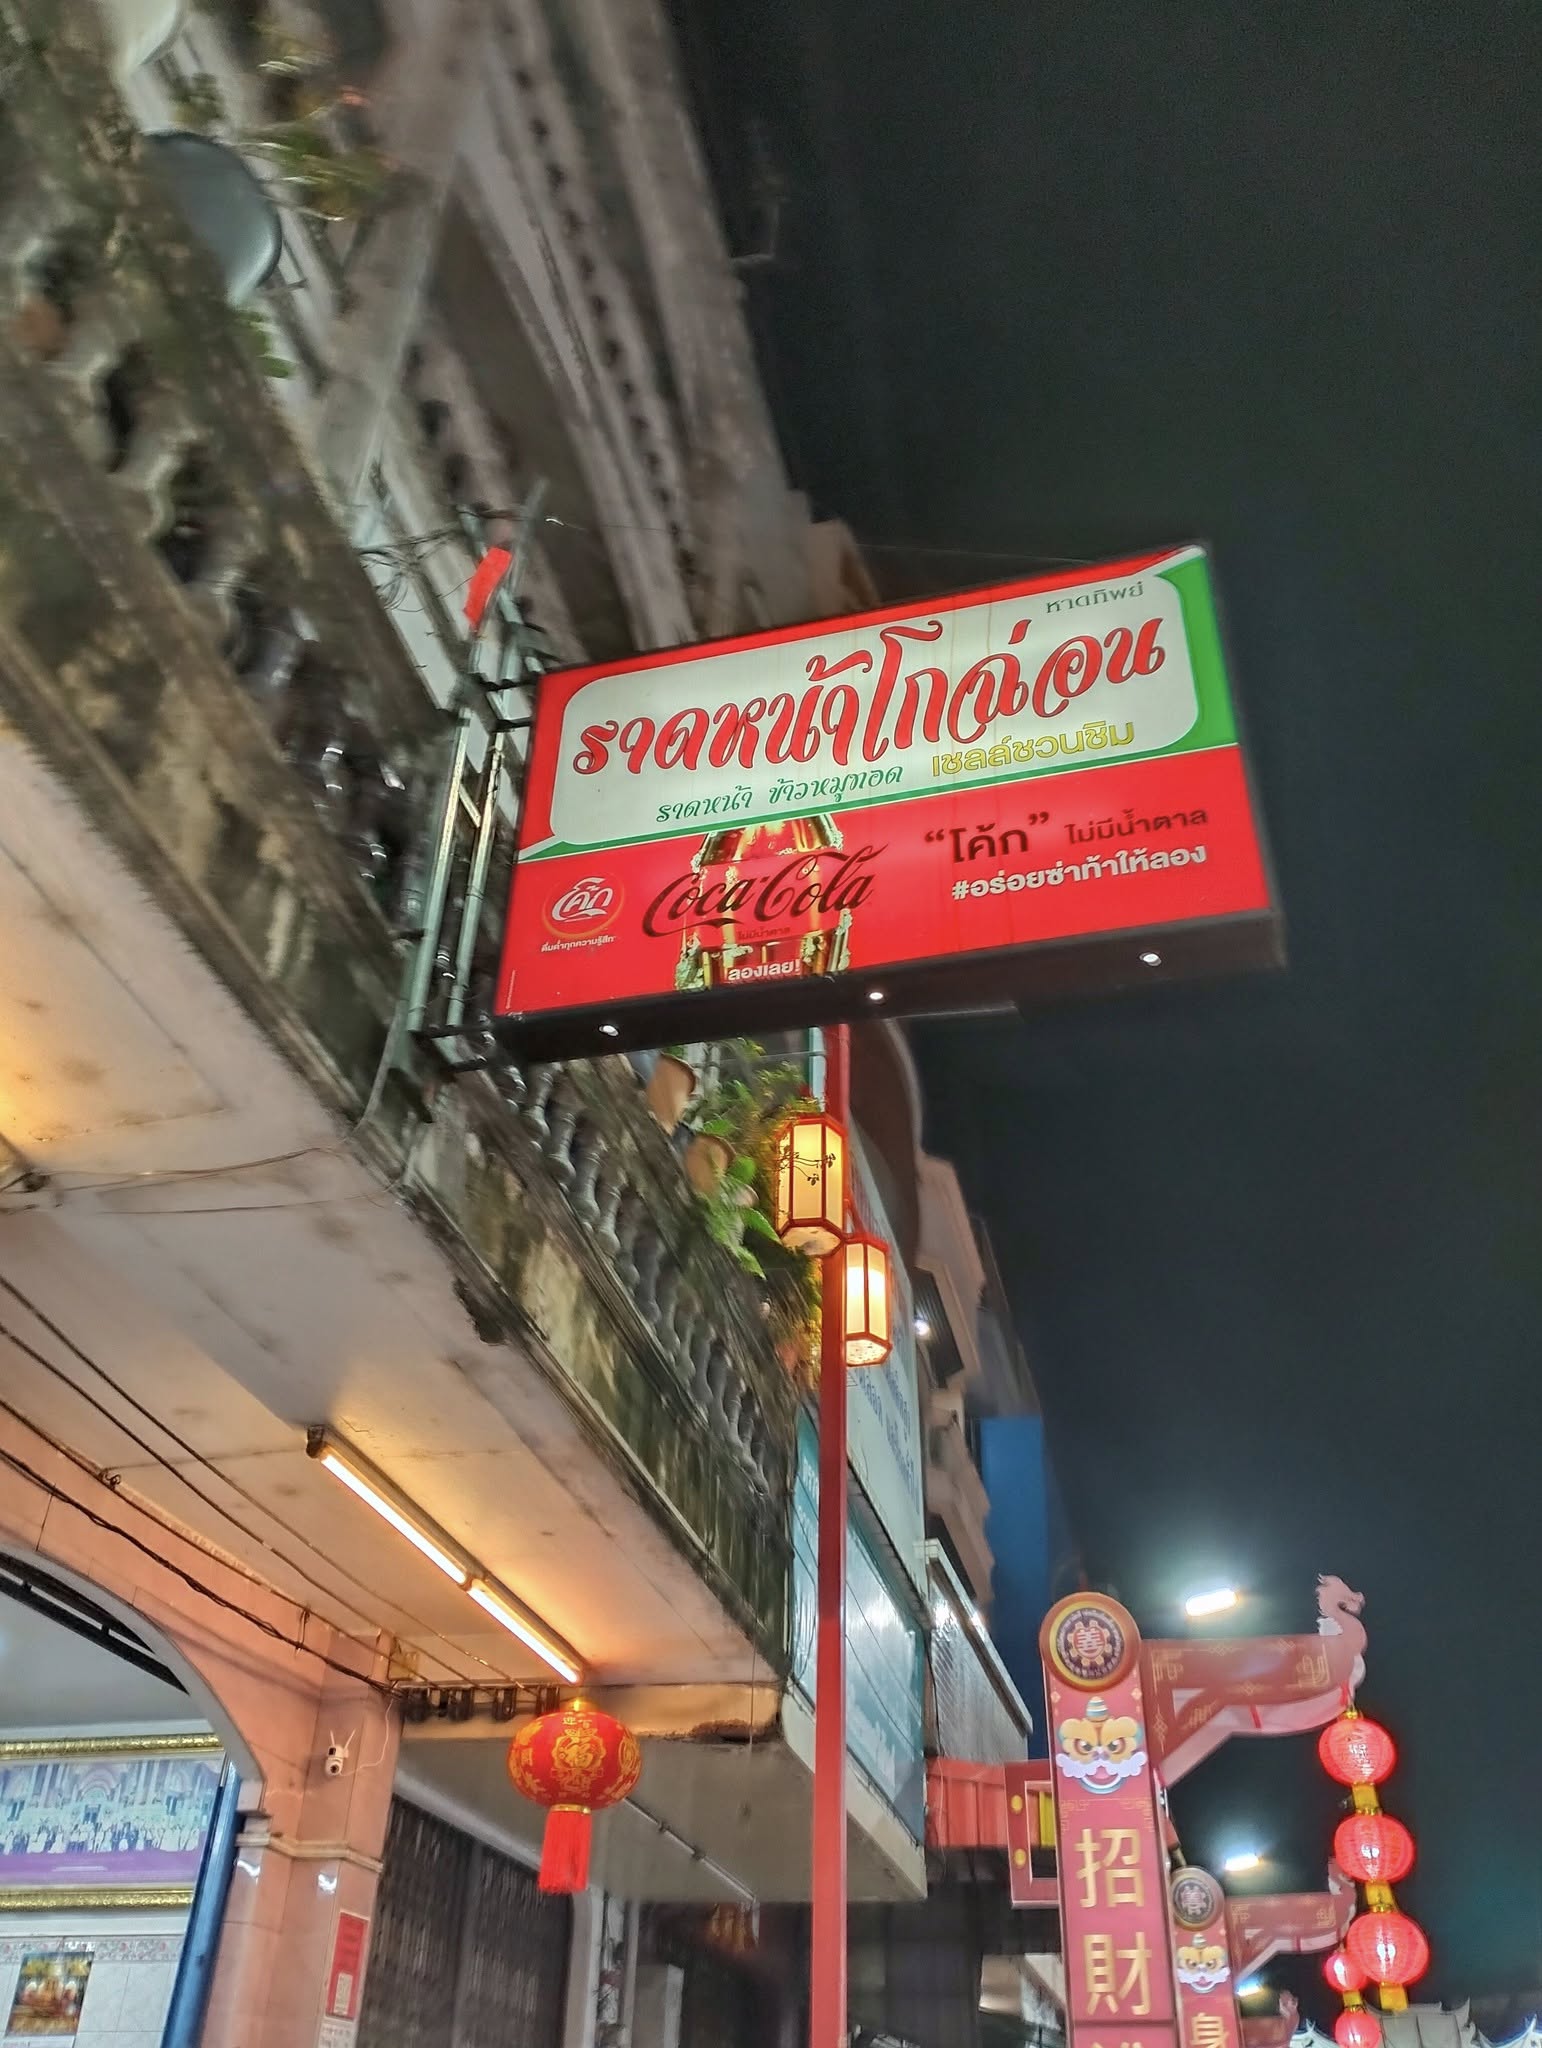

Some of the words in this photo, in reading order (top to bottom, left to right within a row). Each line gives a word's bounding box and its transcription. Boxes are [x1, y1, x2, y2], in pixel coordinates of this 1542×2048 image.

[1046, 581, 1144, 613] หาดทิพย์
[932, 720, 1135, 777] เชลล์ชวนชิม
[656, 785, 753, 823] ราดหน้า
[769, 766, 904, 802] ข้าวหมูทอด
[1064, 808, 1208, 845] ไม่มีน้ำตาล
[642, 843, 888, 937] Coca-Cola
[952, 845, 1207, 900] #อร่อยซ่าท้าให้ลอง
[728, 958, 801, 981] ลองเลย!
